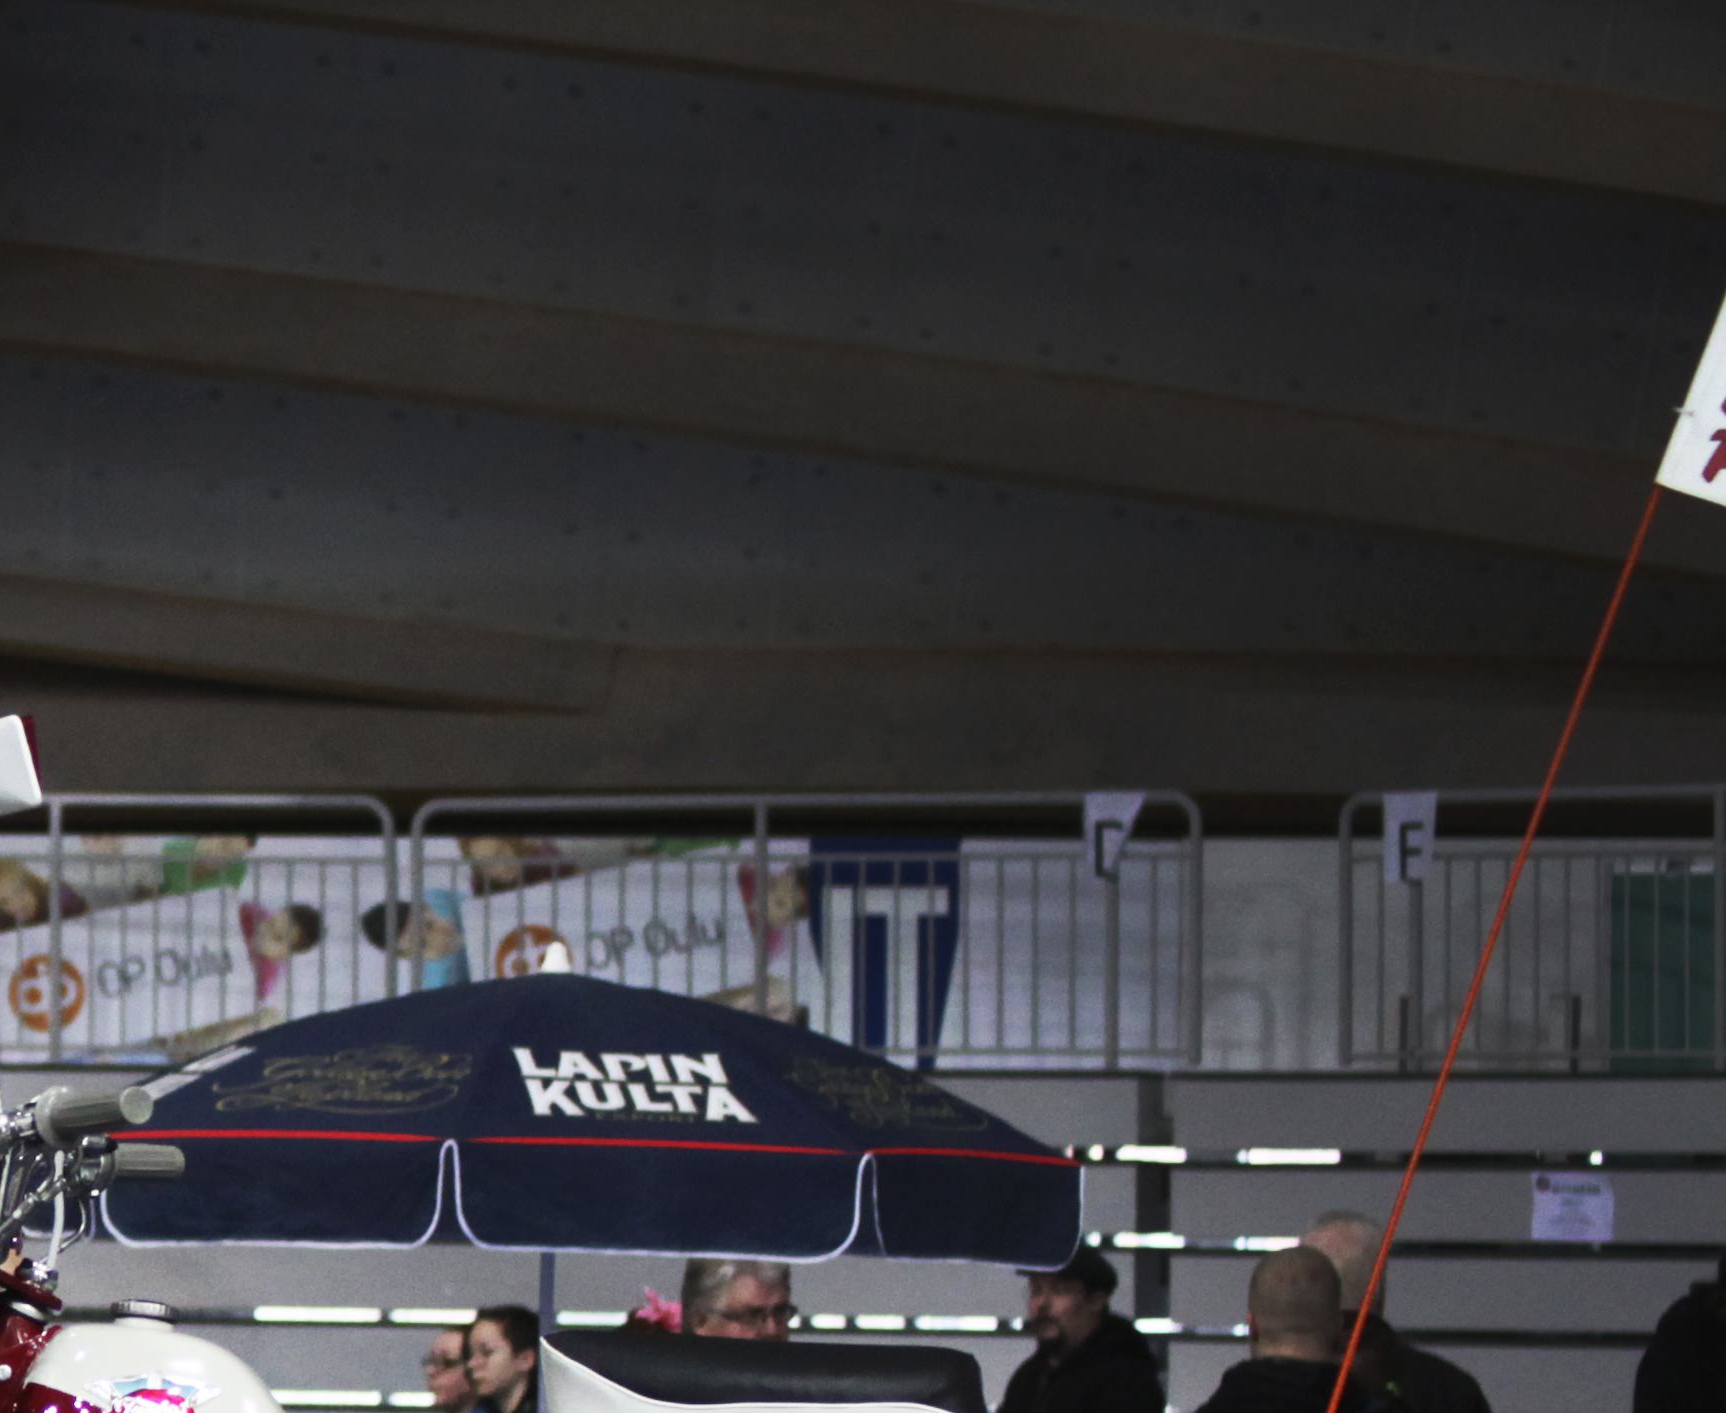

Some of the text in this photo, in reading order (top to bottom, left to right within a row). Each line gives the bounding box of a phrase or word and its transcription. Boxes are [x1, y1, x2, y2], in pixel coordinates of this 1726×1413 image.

[97, 954, 145, 997] OP
[512, 1046, 730, 1083] LAPIN
[524, 1078, 759, 1123] KULTA
